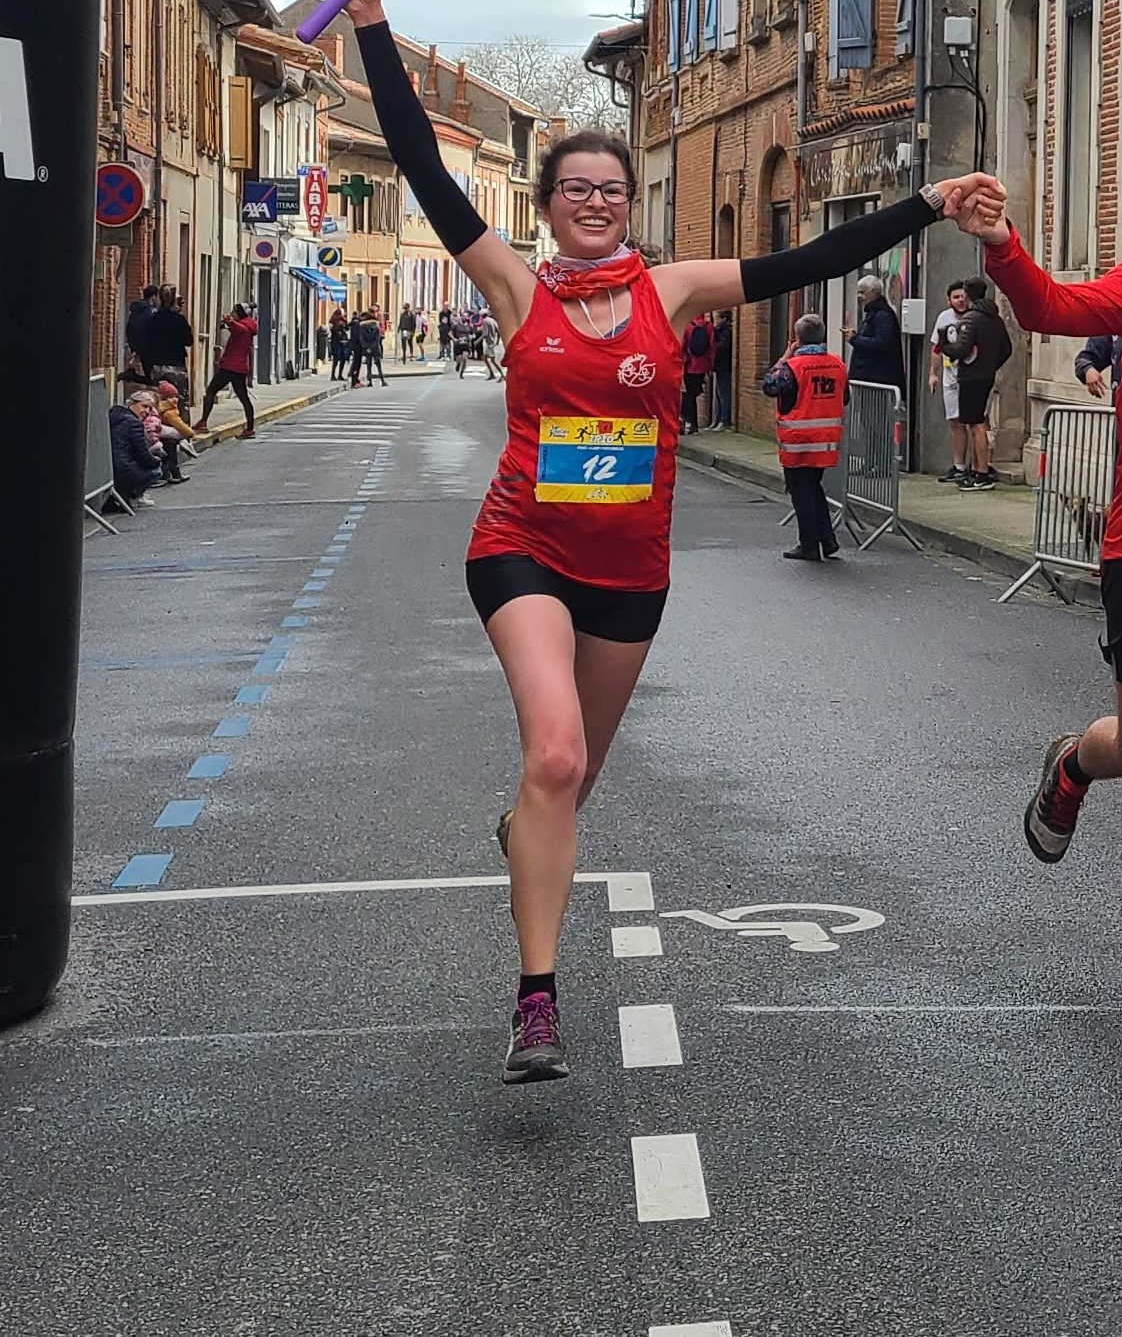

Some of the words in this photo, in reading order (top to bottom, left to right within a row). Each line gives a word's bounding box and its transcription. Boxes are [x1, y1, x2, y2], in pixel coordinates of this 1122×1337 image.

[242, 203, 270, 218] AXA
[308, 170, 322, 227] TABAC
[582, 454, 619, 483] 12
